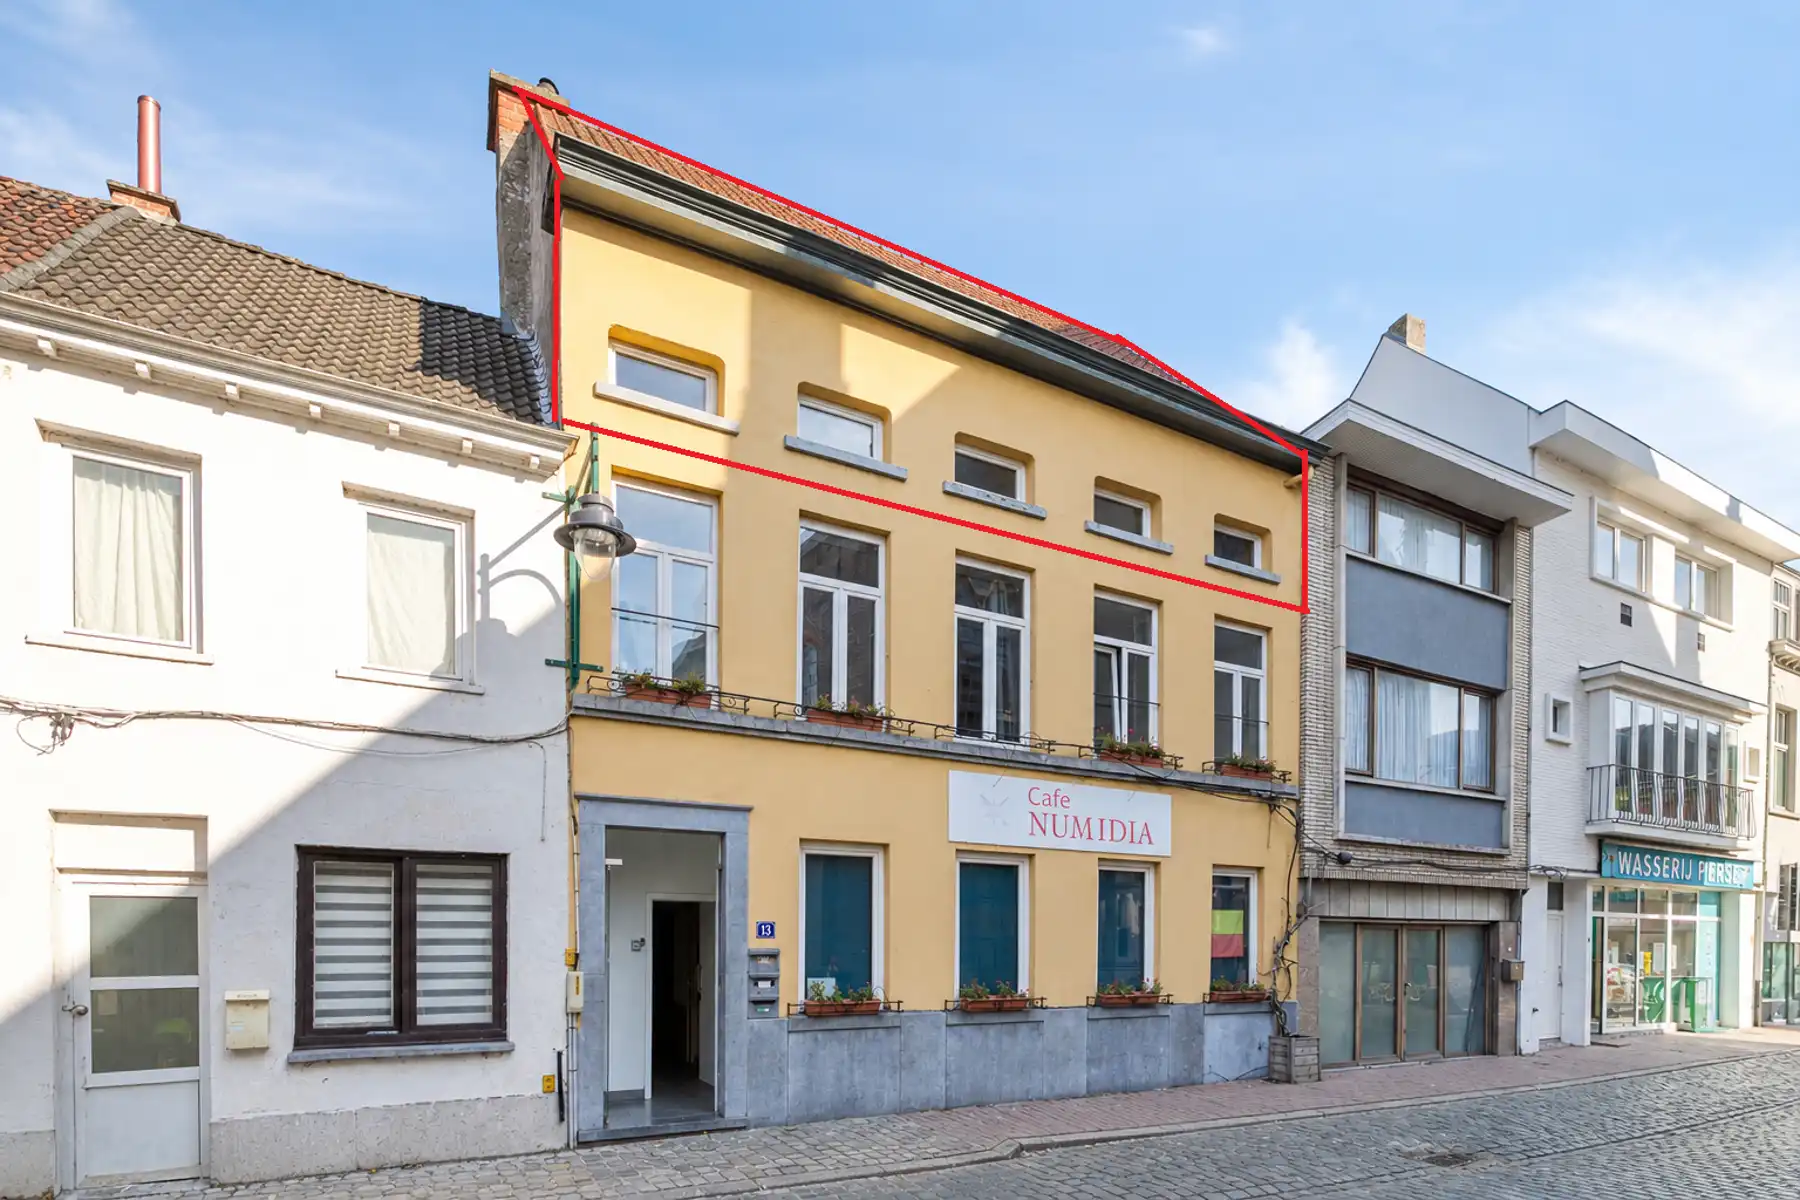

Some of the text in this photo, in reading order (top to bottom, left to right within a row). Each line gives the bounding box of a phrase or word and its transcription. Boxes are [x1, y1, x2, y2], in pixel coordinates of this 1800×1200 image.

[1028, 786, 1071, 809] Cafe
[1028, 811, 1155, 845] NUMIDIA
[1618, 851, 1692, 880] WASSERIJ
[761, 924, 772, 936] 13
